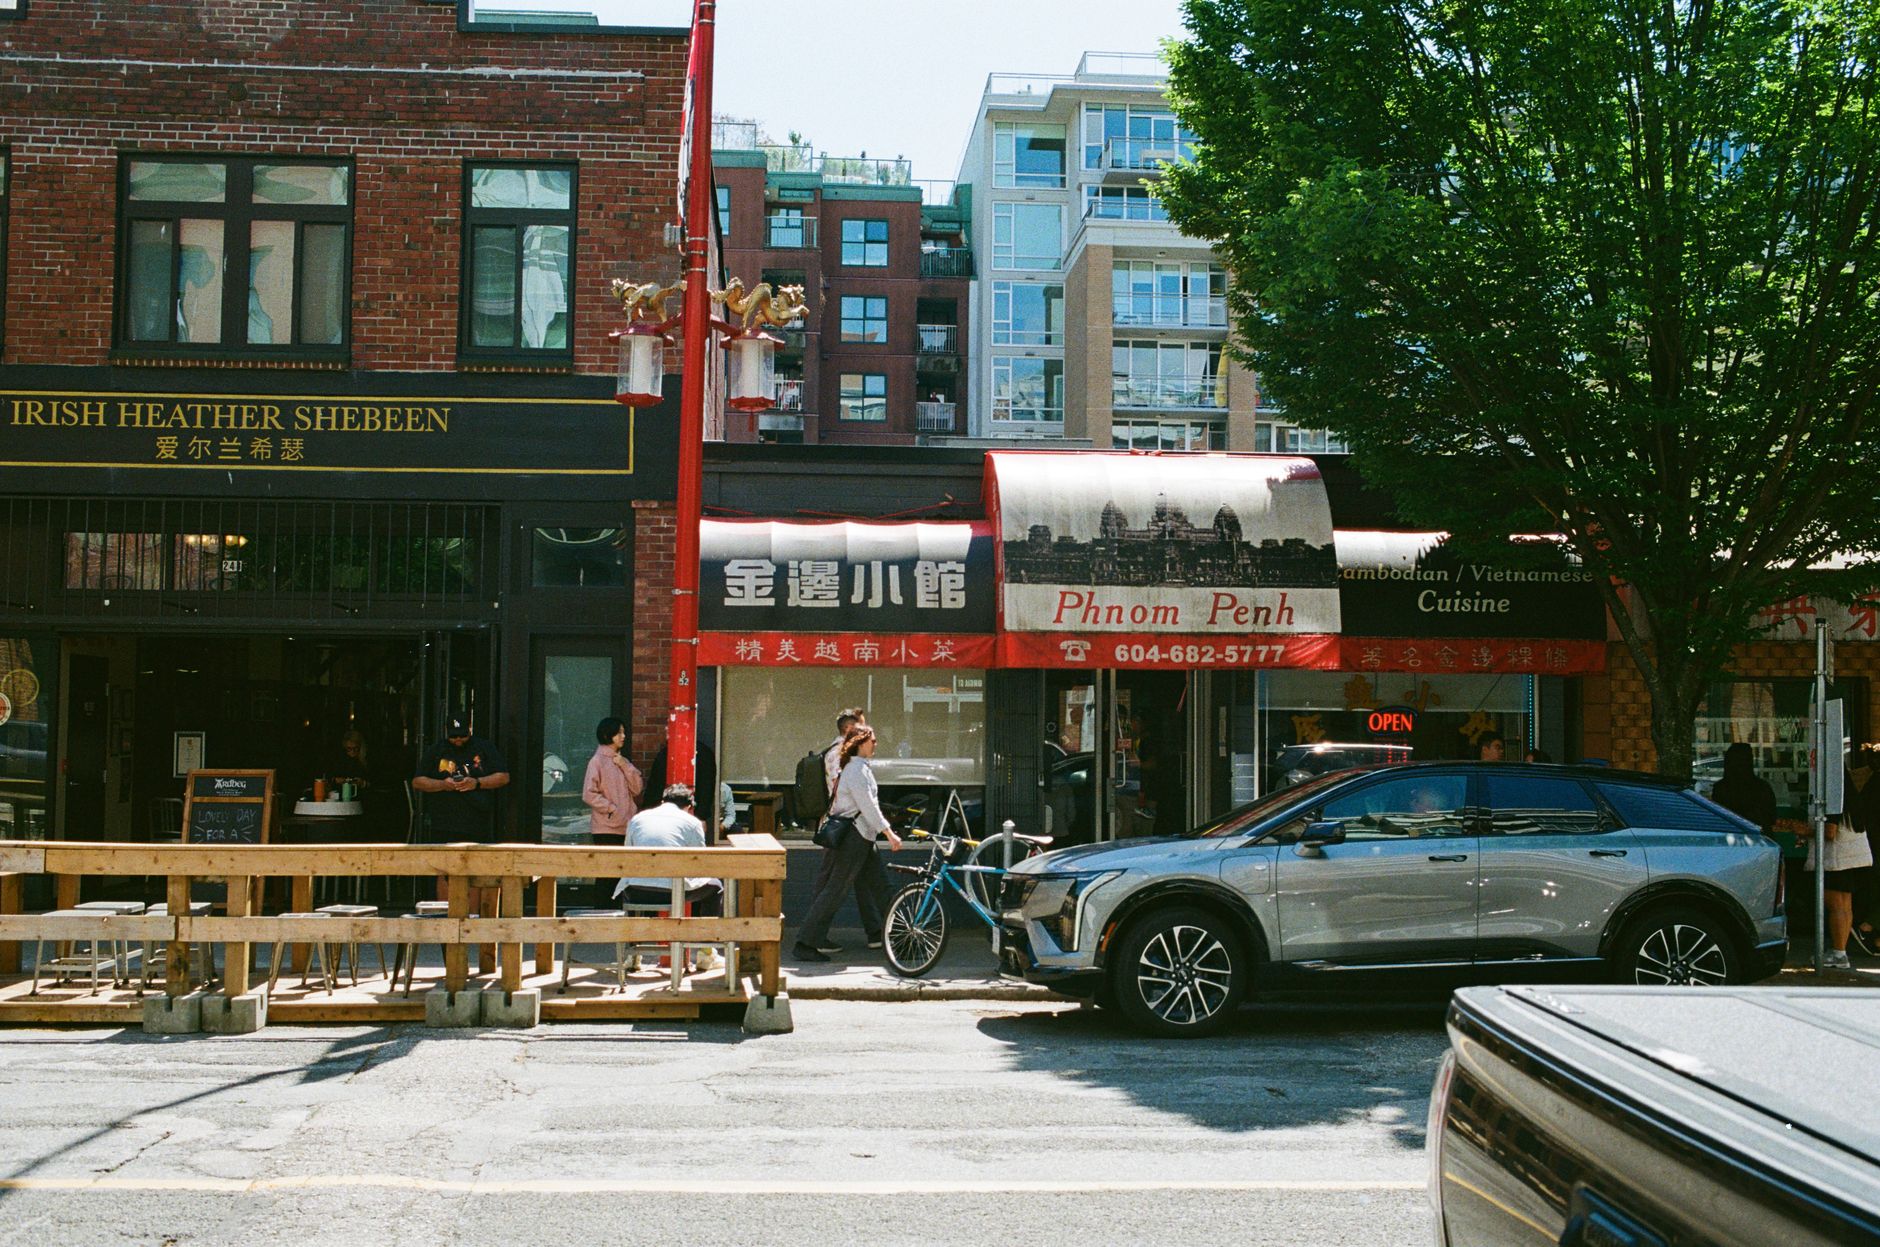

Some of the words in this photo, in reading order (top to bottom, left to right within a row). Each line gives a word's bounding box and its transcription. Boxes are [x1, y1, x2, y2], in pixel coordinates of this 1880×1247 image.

[10, 400, 107, 426] IRISH
[117, 402, 285, 430] HEATHER
[294, 405, 451, 432] SHEBEEN
[156, 435, 304, 461] 爱尔兰希瑟
[723, 558, 966, 609] 金邊小館
[1338, 563, 1449, 582] ambodian
[1470, 564, 1593, 583] Vietnamese
[1052, 591, 1180, 625] Phnom
[1206, 592, 1295, 626] Penh
[1417, 590, 1511, 613] Cuisine
[735, 638, 957, 663] 精美越南小菜
[1114, 644, 1285, 663] 604-682-5777
[1368, 712, 1413, 732] OPEN
[206, 829, 226, 841] FOR
[230, 828, 238, 841] A
